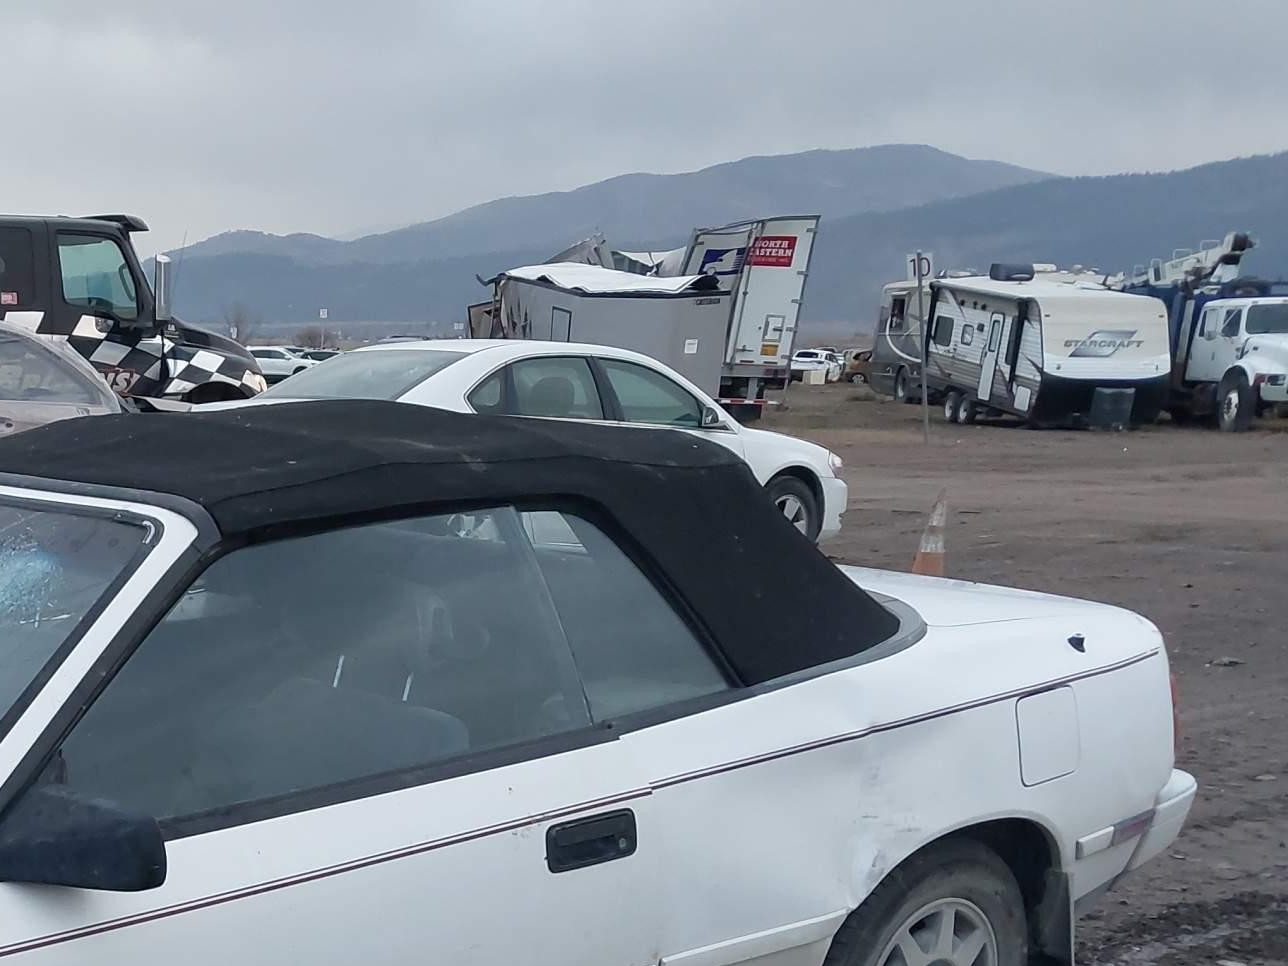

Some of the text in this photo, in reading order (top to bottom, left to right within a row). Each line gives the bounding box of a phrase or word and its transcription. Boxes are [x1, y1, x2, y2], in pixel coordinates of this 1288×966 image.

[754, 240, 789, 248] NORTH
[749, 248, 793, 256] EASTERN
[910, 257, 931, 277] 10
[1063, 339, 1145, 349] STARCRAFT
